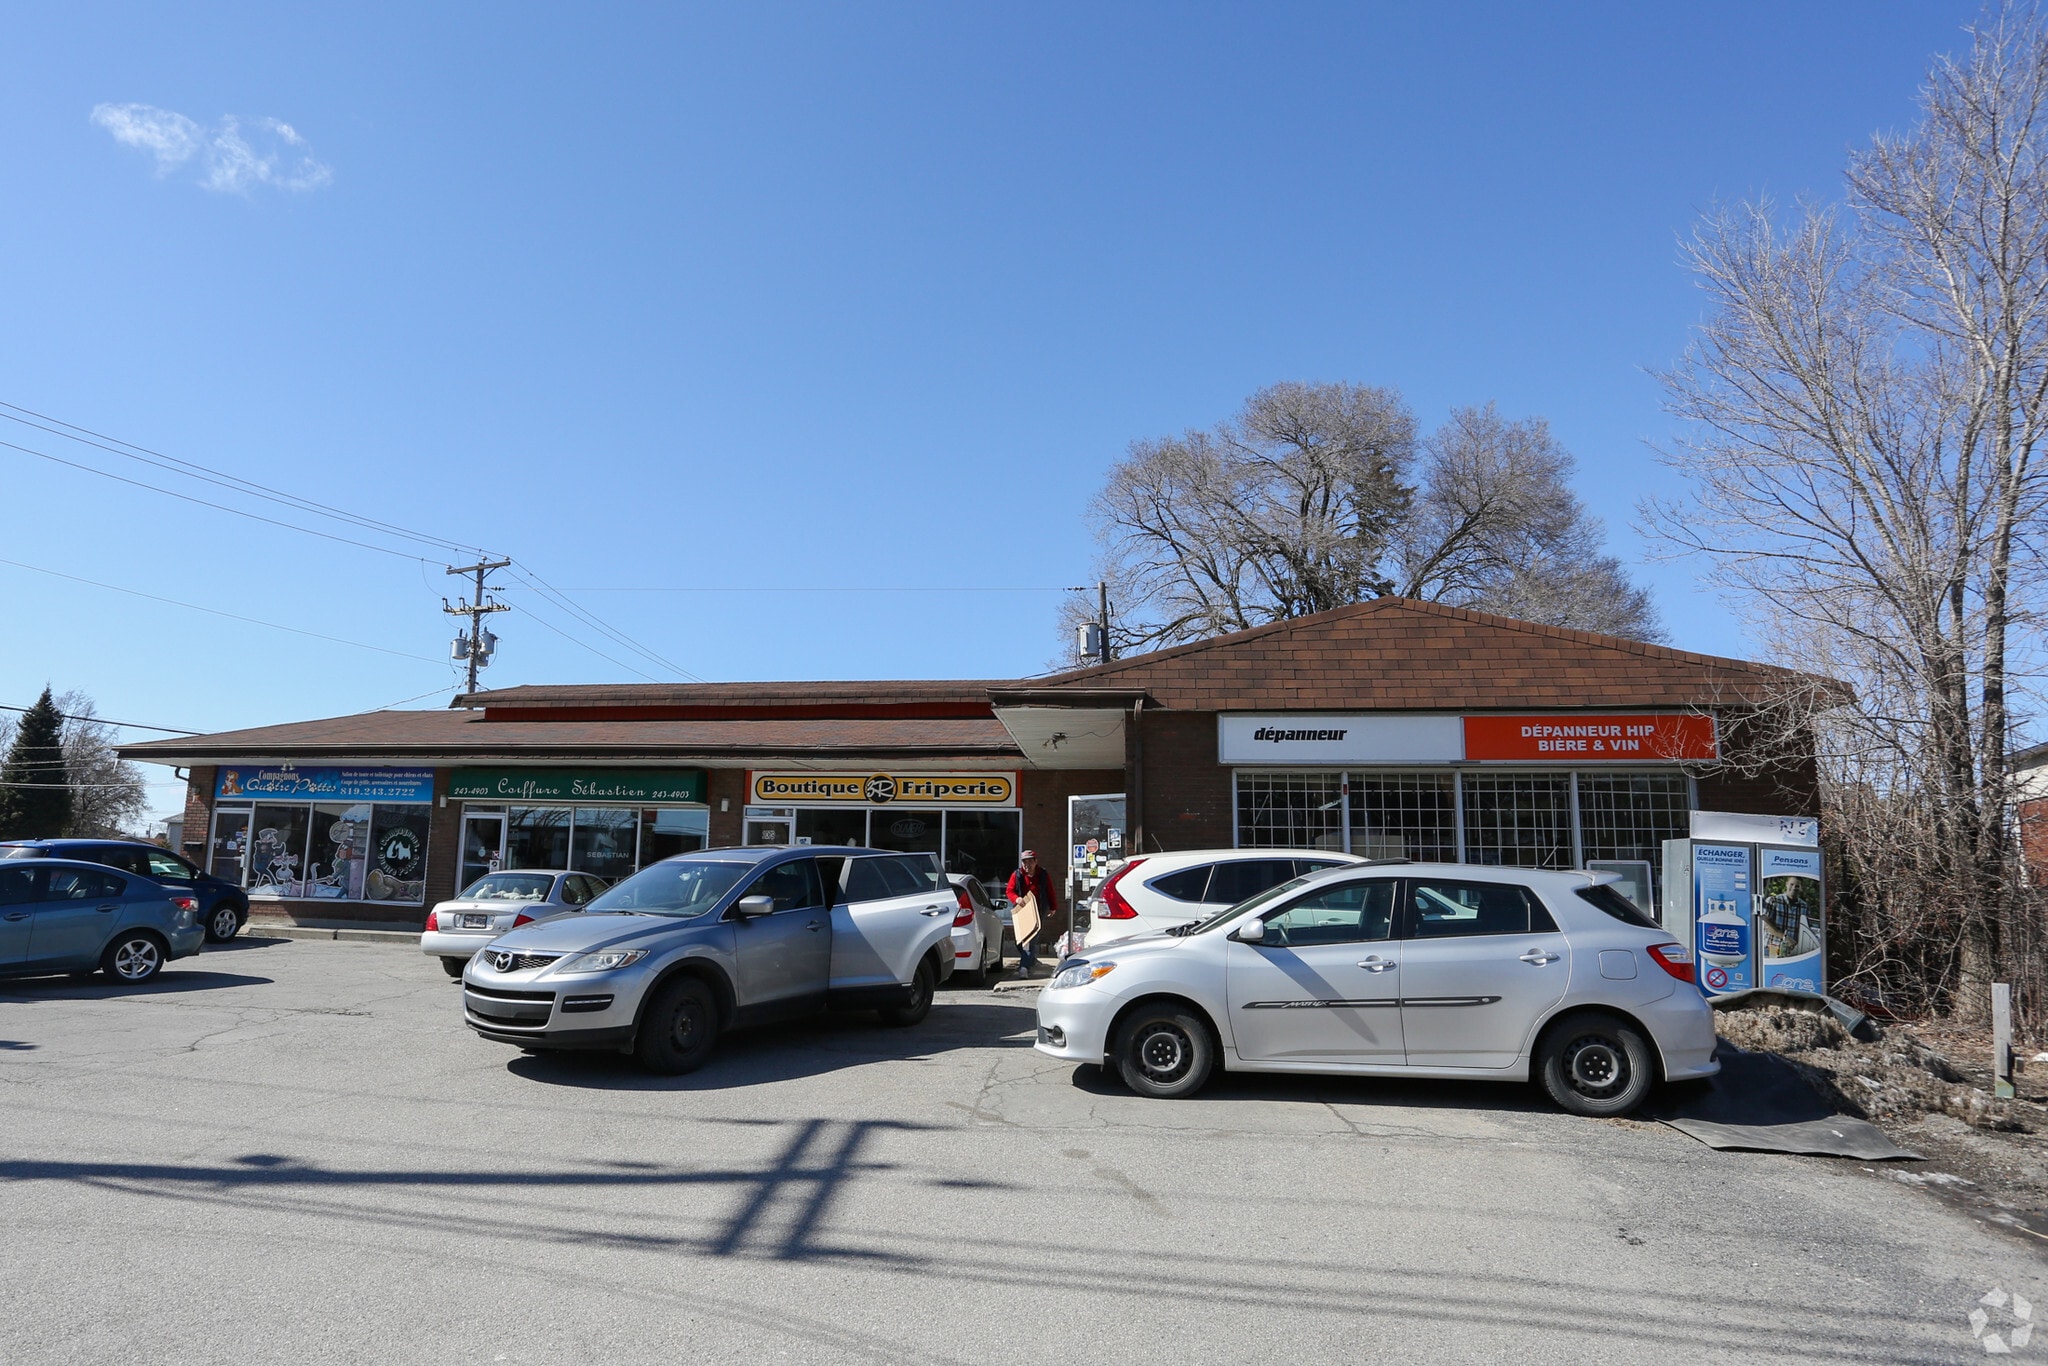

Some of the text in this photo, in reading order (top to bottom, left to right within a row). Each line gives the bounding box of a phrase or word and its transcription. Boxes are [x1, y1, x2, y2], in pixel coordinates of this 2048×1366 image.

[1254, 726, 1347, 743] dépanneur
[1521, 724, 1655, 737] DÉPANNEUR HIP
[1538, 738, 1639, 751] BIÈRE & VIN
[258, 769, 299, 783] Compagnons
[340, 787, 415, 796] 819.243.2722
[454, 778, 690, 798] 243-4903 Coiffure Sébastien 243-4903
[761, 779, 859, 798] Boutique
[902, 780, 1004, 799] Friperie
[586, 851, 629, 859] SEBASTIAN
[1773, 855, 1809, 864] Pensons
